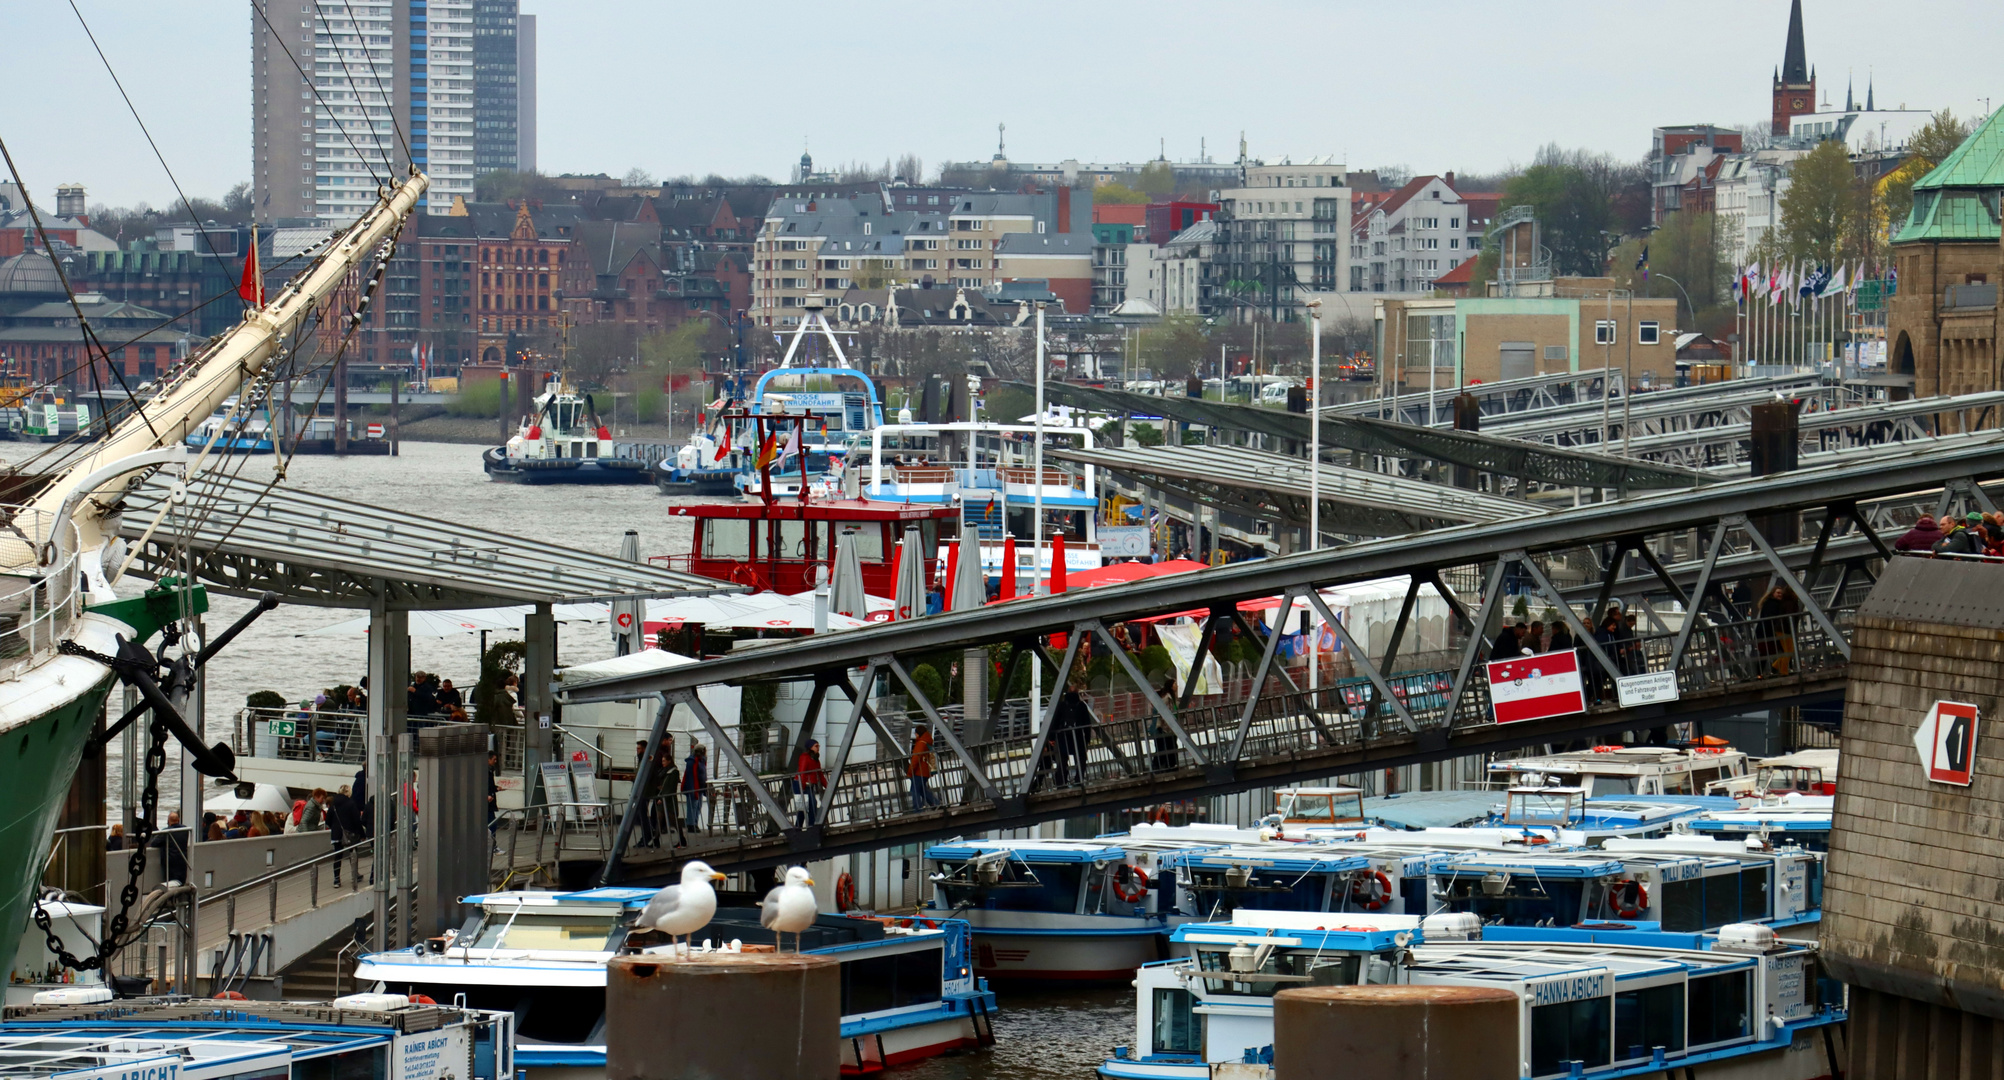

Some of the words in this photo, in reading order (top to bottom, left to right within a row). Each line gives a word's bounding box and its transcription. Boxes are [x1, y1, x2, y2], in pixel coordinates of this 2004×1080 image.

[1621, 679, 1653, 688] Ausgenommen
[1634, 686, 1657, 694] Fahrzeuge
[1957, 724, 1964, 764] 1
[1662, 866, 1679, 882] WILLI
[1681, 863, 1702, 879] ABICHT
[1536, 981, 1569, 1006] HANNA
[1571, 975, 1605, 1001] ABICHT
